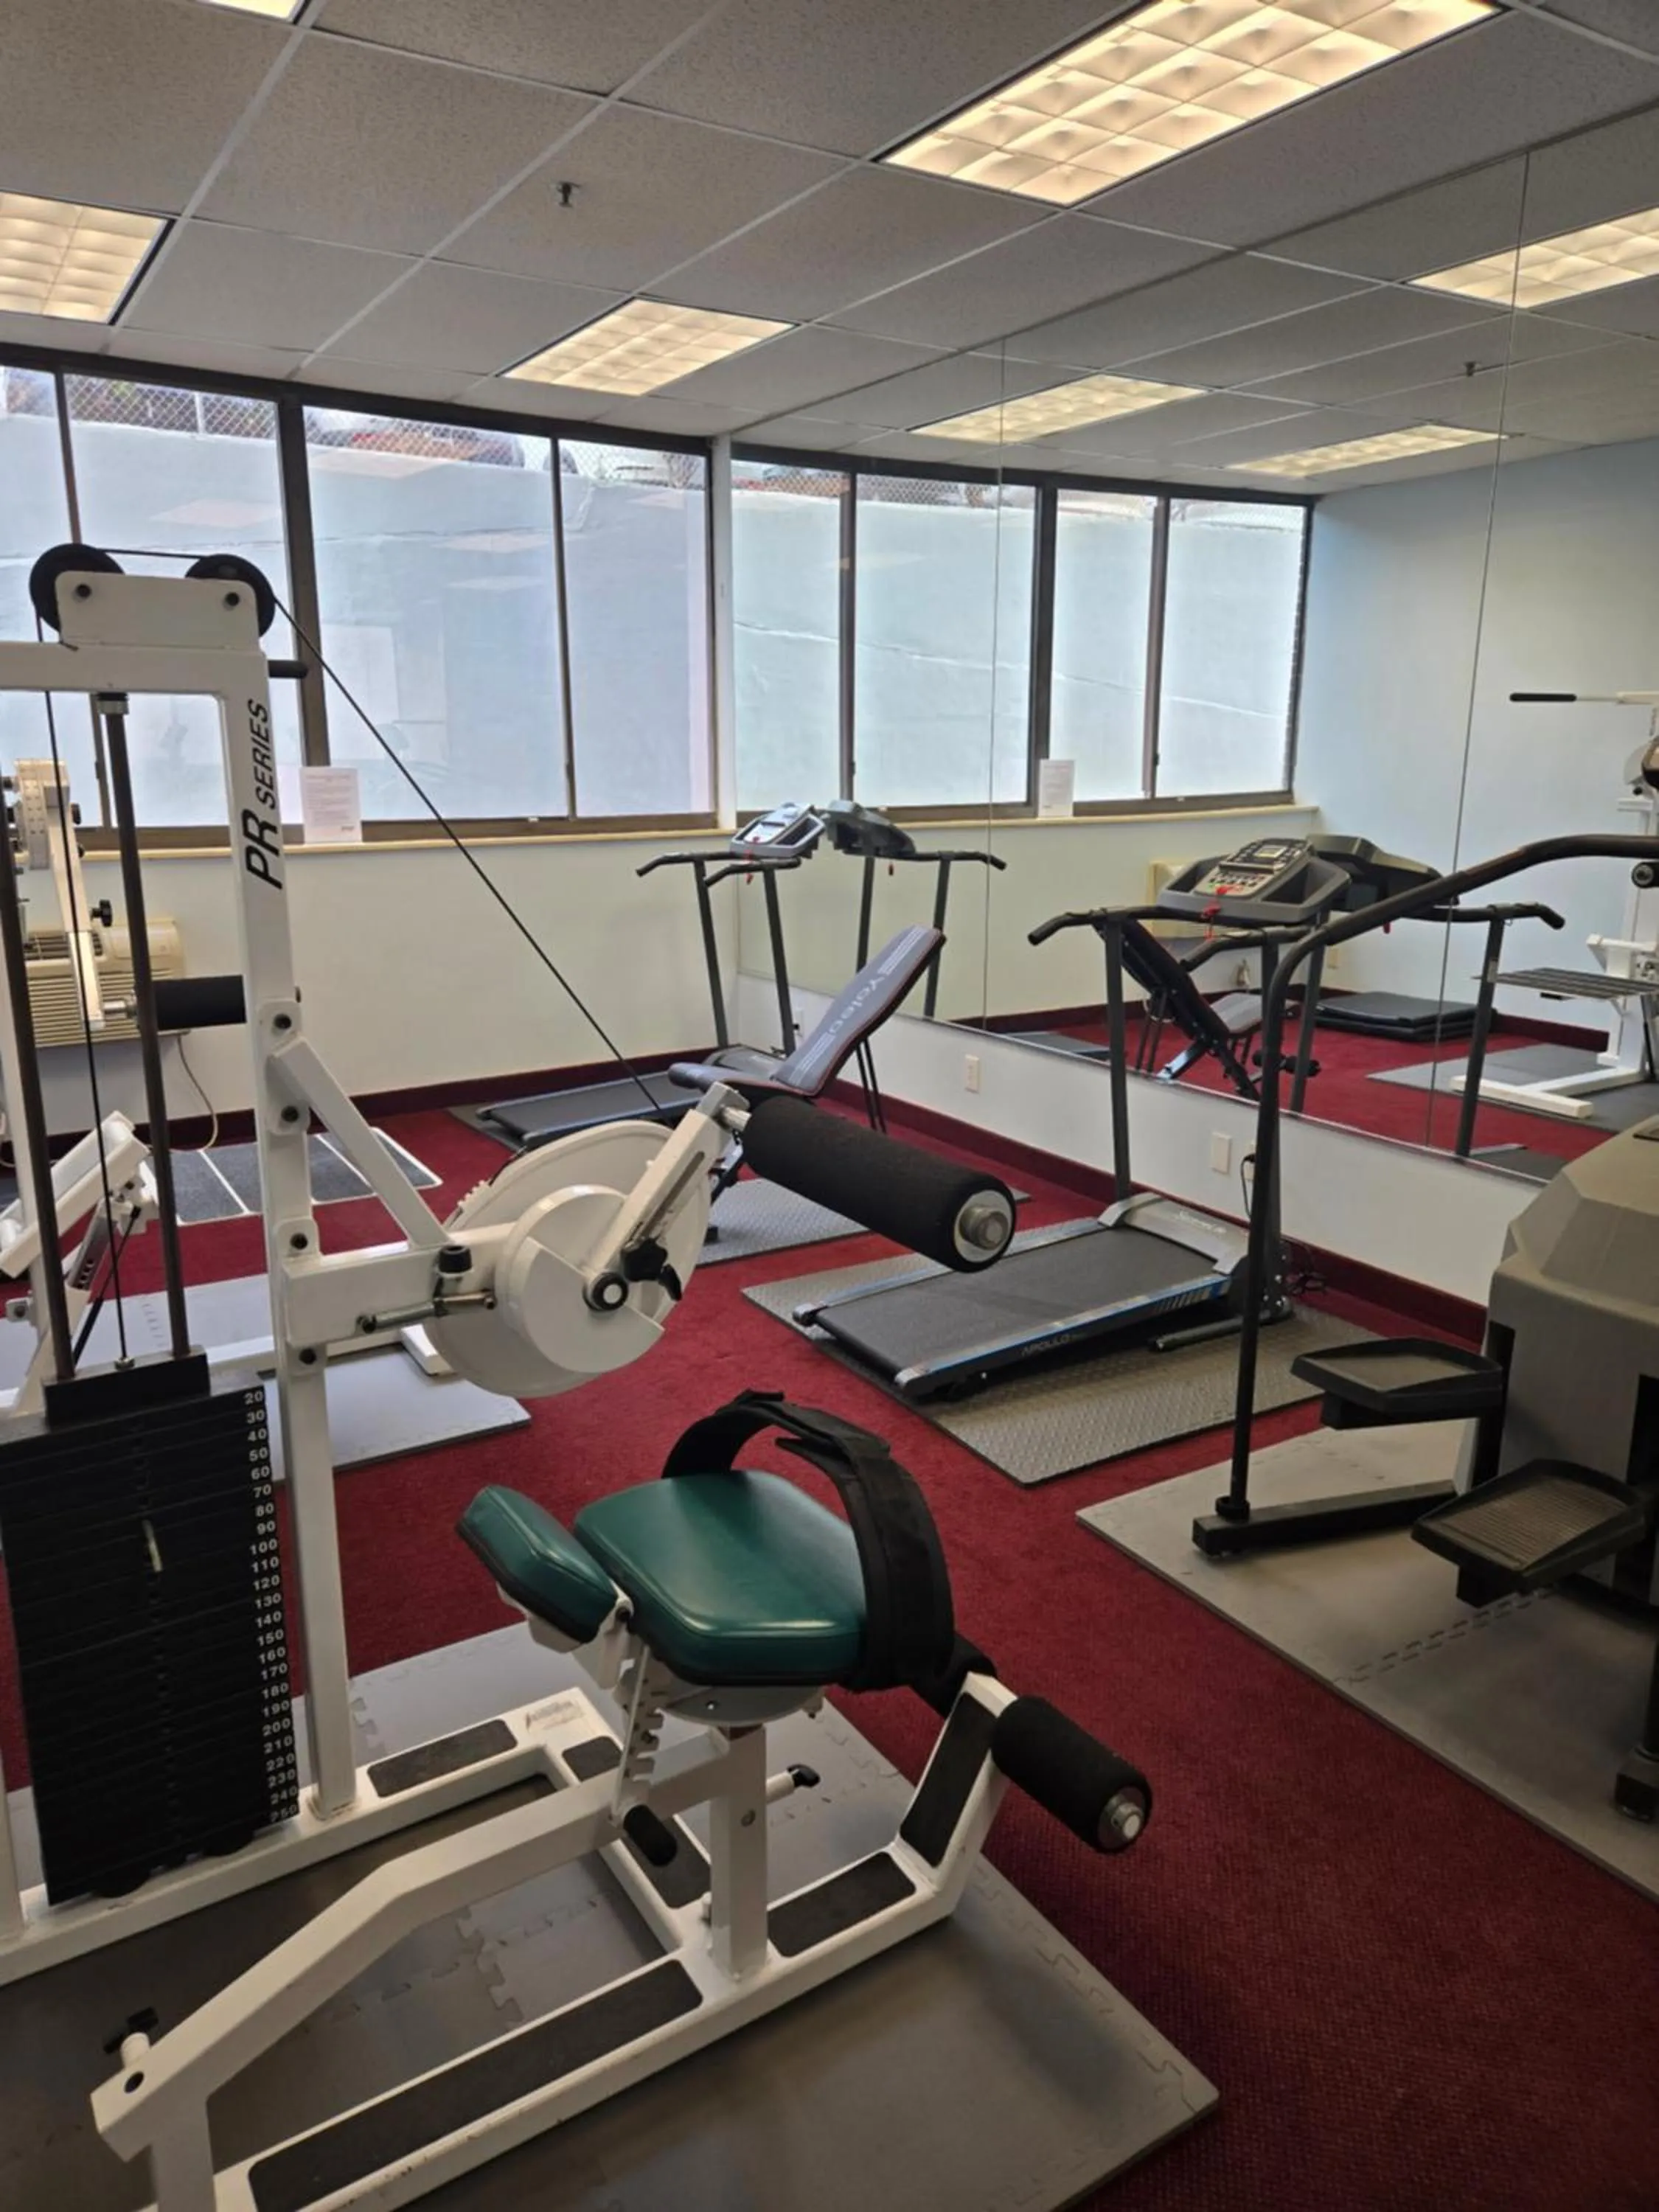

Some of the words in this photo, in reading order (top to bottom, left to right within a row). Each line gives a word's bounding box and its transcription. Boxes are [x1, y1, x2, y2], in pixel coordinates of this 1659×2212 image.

[248, 698, 276, 810] SERIES
[241, 809, 282, 889] PR
[244, 1391, 264, 1404] 20
[247, 1410, 265, 1424] 30
[248, 1429, 267, 1441] 40
[249, 1447, 268, 1461] 50
[251, 1466, 270, 1479] 60
[254, 1484, 272, 1498] 70
[256, 1503, 274, 1517] 80
[257, 1520, 276, 1534] 90
[250, 1539, 278, 1554] 100
[251, 1557, 279, 1572] 110
[253, 1575, 280, 1590] 120
[255, 1593, 282, 1608] 130
[256, 1611, 282, 1628] 140
[257, 1629, 284, 1646] 150
[259, 1646, 286, 1663] 160
[261, 1663, 288, 1680] 170
[262, 1682, 289, 1699] 180
[263, 1700, 290, 1717] 190
[262, 1718, 291, 1736] 200
[263, 1735, 293, 1753] 210
[266, 1753, 294, 1771] 220
[268, 1770, 296, 1787] 230
[270, 1787, 297, 1804] 240
